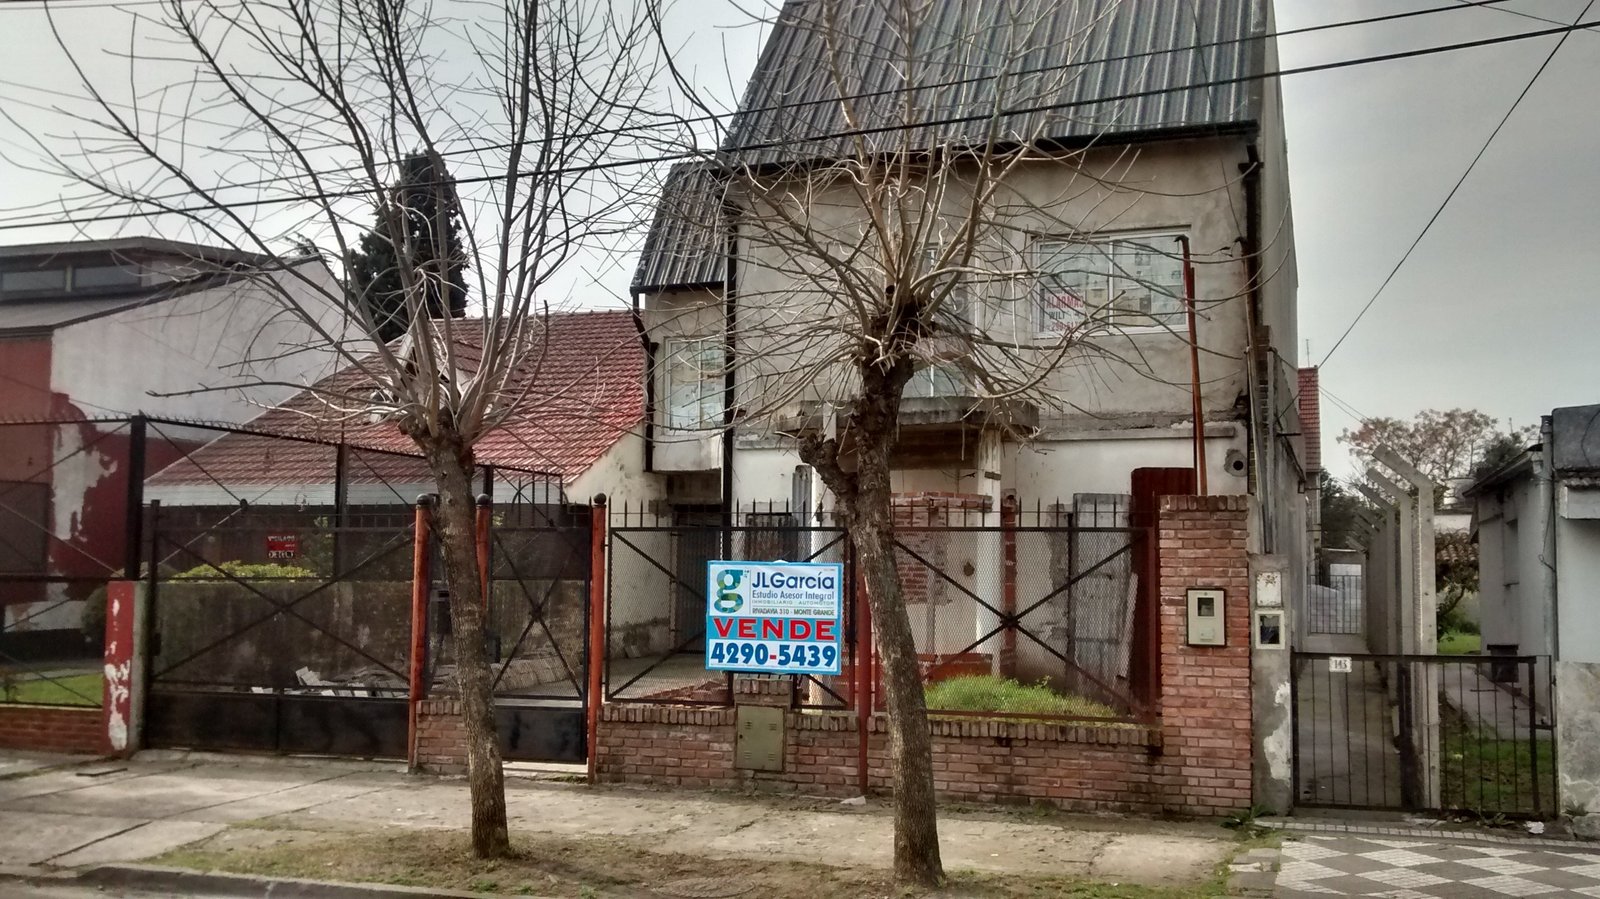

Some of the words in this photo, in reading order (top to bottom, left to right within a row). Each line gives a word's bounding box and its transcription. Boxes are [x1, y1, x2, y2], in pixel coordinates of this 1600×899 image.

[1046, 295, 1084, 309] ALARMAS
[752, 571, 834, 589] JLGarcía
[752, 590, 778, 599] Estudio
[779, 591, 803, 600] Asesor
[805, 591, 834, 602] Integral
[713, 618, 835, 641] VENDE
[711, 642, 836, 667] 4290-5439
